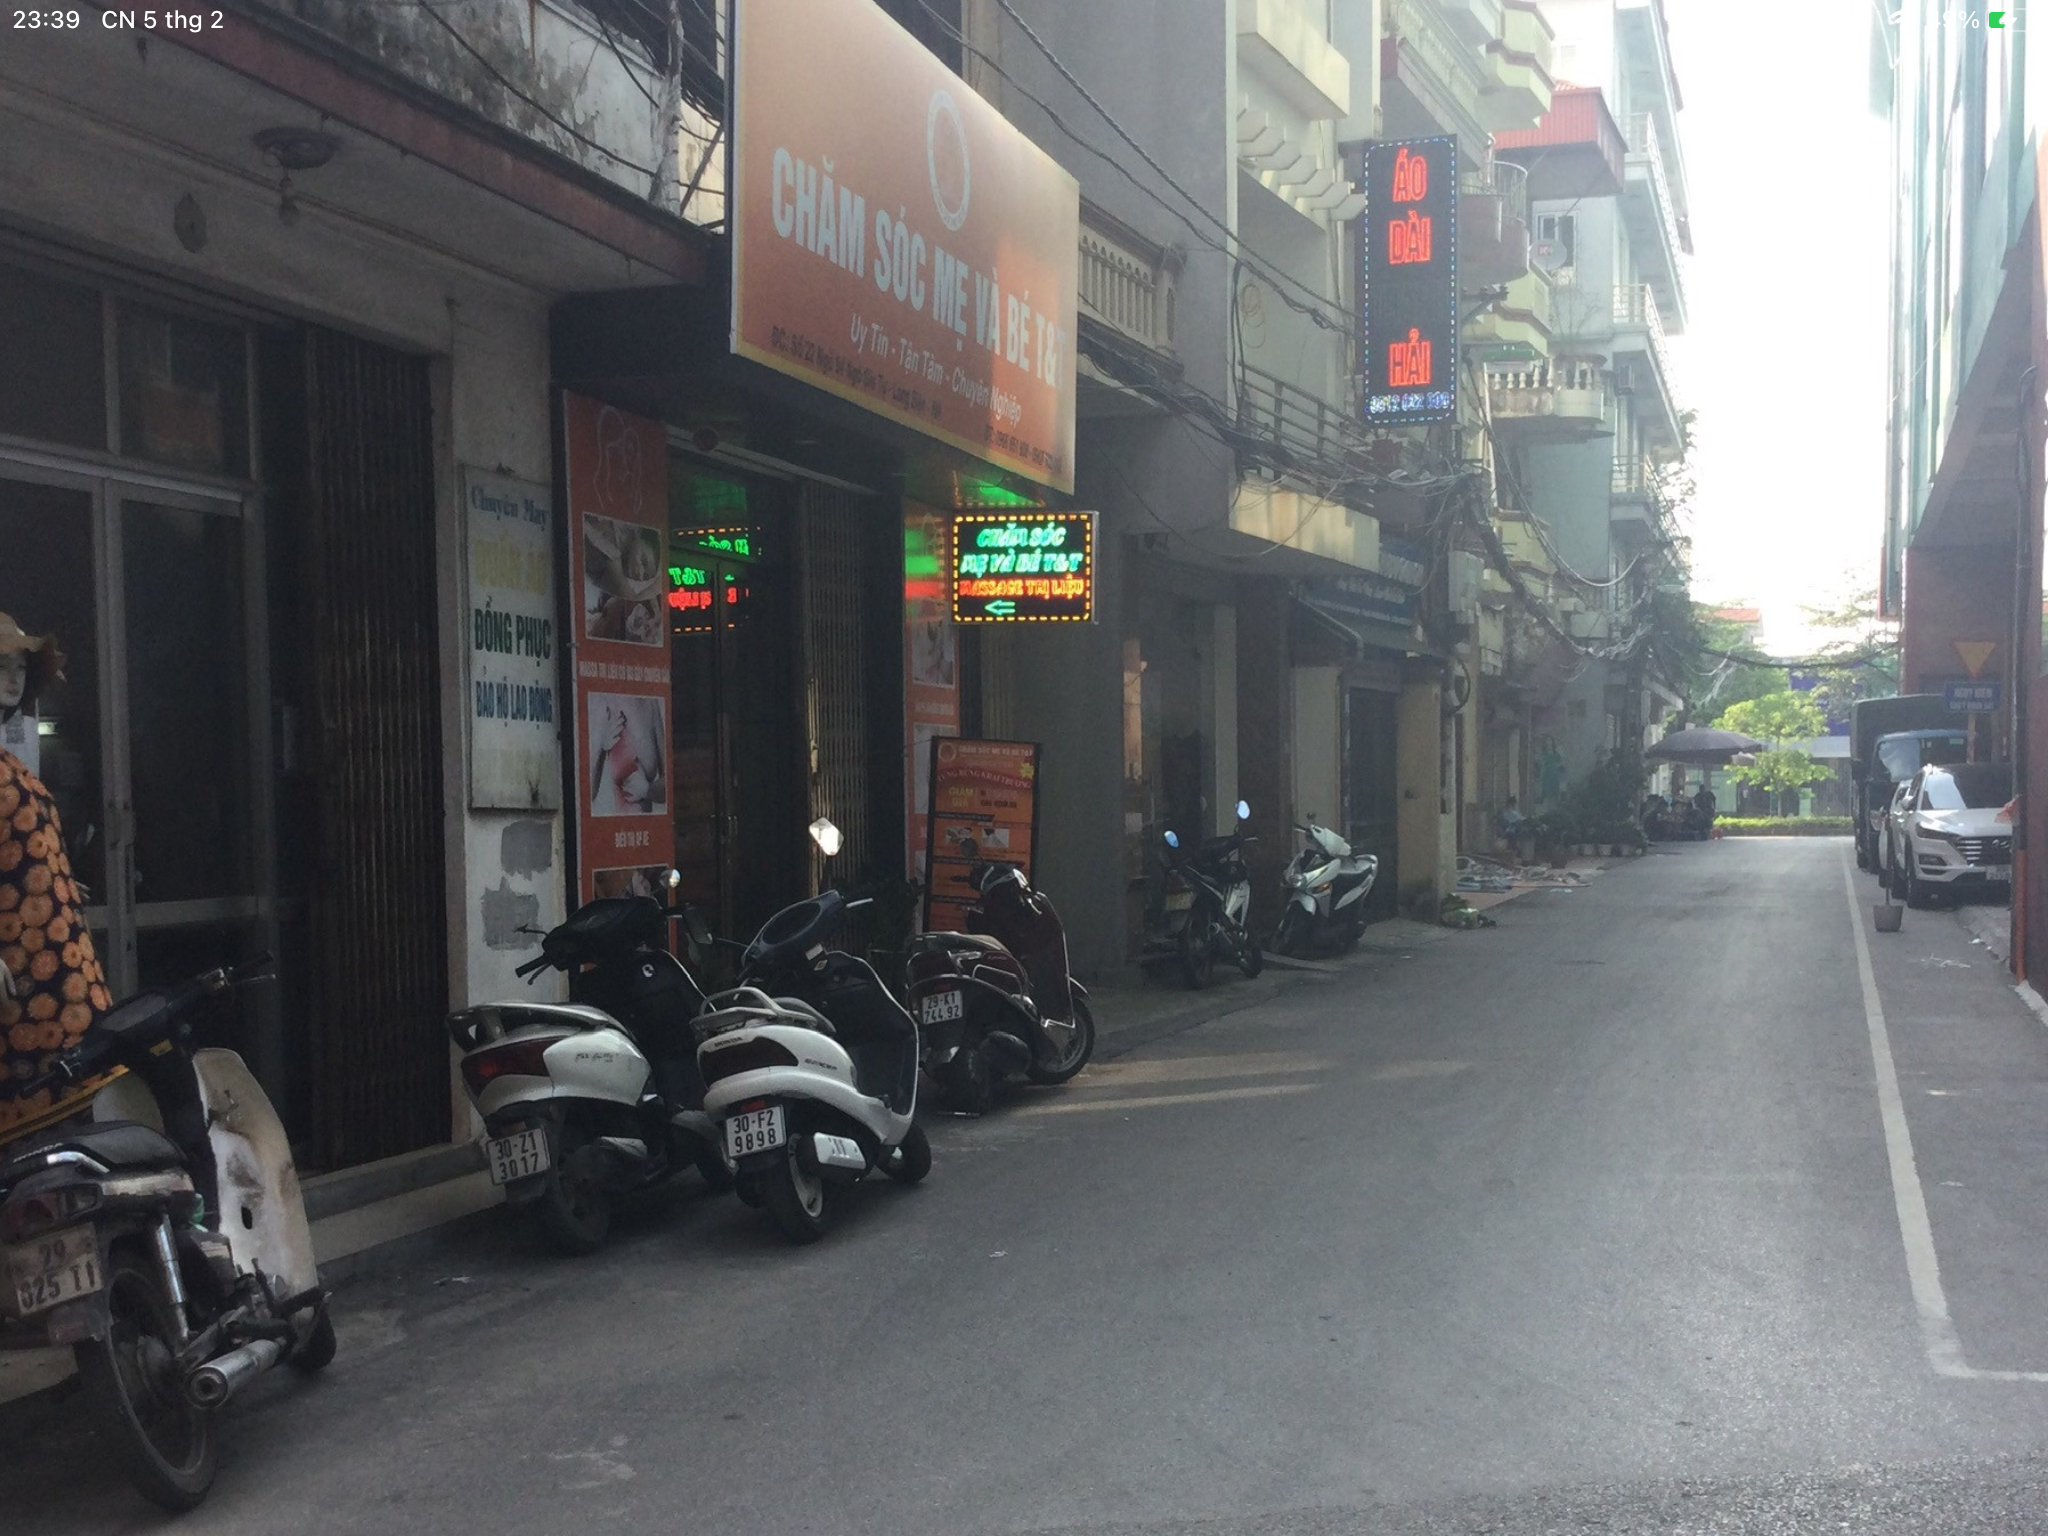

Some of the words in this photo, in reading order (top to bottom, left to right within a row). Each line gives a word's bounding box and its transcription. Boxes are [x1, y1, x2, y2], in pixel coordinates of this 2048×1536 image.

[1393, 147, 1427, 202] ÁO
[1389, 209, 1431, 264] DÀI
[772, 147, 865, 279] CHĂM
[874, 205, 926, 311] SÓC
[932, 247, 969, 352] MẸ
[975, 267, 1000, 356] VÀ
[1006, 289, 1030, 372] BÉ
[850, 312, 868, 354] Uy
[871, 323, 889, 358] Tín
[900, 338, 919, 375] Tận
[922, 348, 944, 385] Tâm
[952, 366, 989, 408] Chuyên
[990, 385, 1022, 428] Nghiệp
[1389, 327, 1431, 387] HẢI
[976, 523, 1028, 548] CHĂM
[1028, 522, 1067, 548] SÓC
[960, 552, 989, 578] MẸ
[989, 548, 1016, 574] VÀ
[1043, 552, 1083, 573] T&T
[959, 579, 1024, 596] MASSAGE
[1025, 579, 1050, 600] TRỊ
[1051, 573, 1084, 600] LIỆU
[474, 595, 513, 655] ĐỒNG
[516, 614, 551, 667] PHỤC
[475, 665, 495, 719] BẢO
[496, 676, 510, 728] HỘ
[511, 684, 527, 721] LAO
[529, 679, 553, 730] ĐỘNG
[733, 1109, 775, 1135] 30-F2
[735, 1128, 776, 1153] 9898
[495, 1132, 537, 1160] 30-Z1
[499, 1153, 539, 1180] 3017
